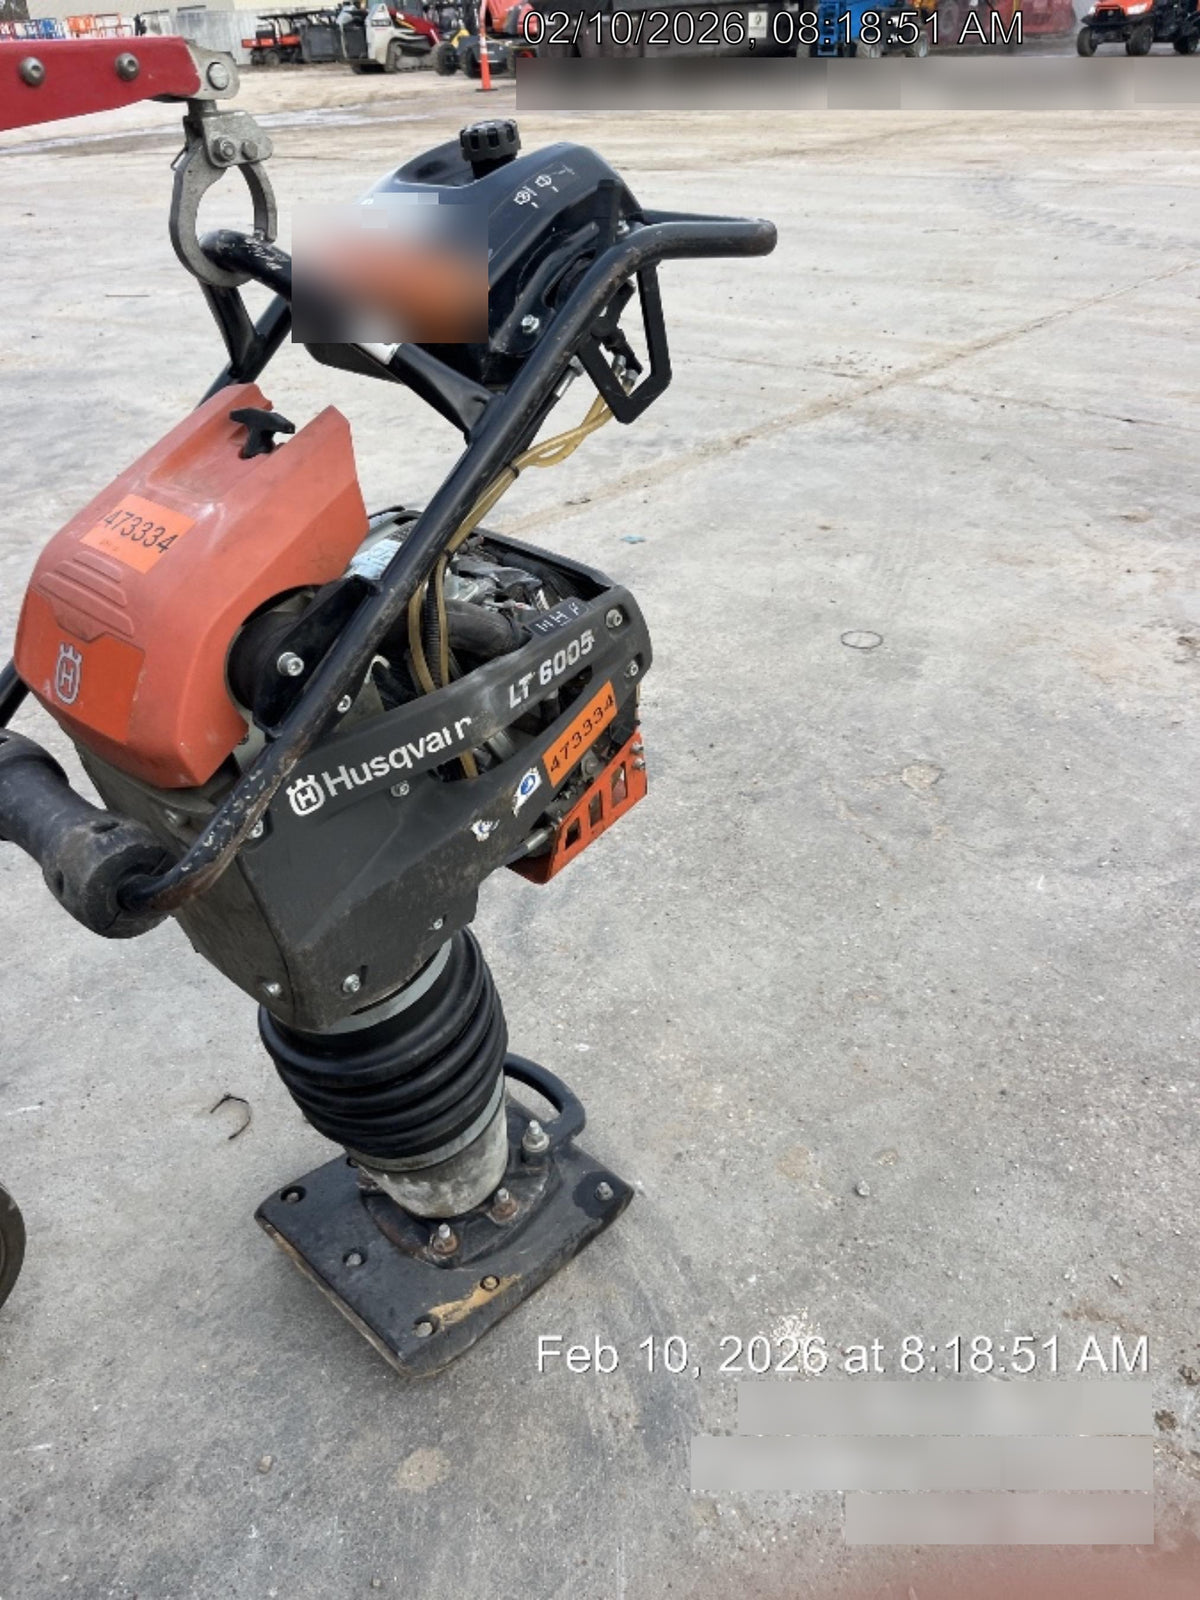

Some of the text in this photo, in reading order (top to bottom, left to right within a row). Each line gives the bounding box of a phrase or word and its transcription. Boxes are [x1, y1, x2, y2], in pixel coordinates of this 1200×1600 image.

[104, 509, 178, 554] 473334
[508, 629, 596, 709] LT 6005
[550, 694, 614, 773] 473334
